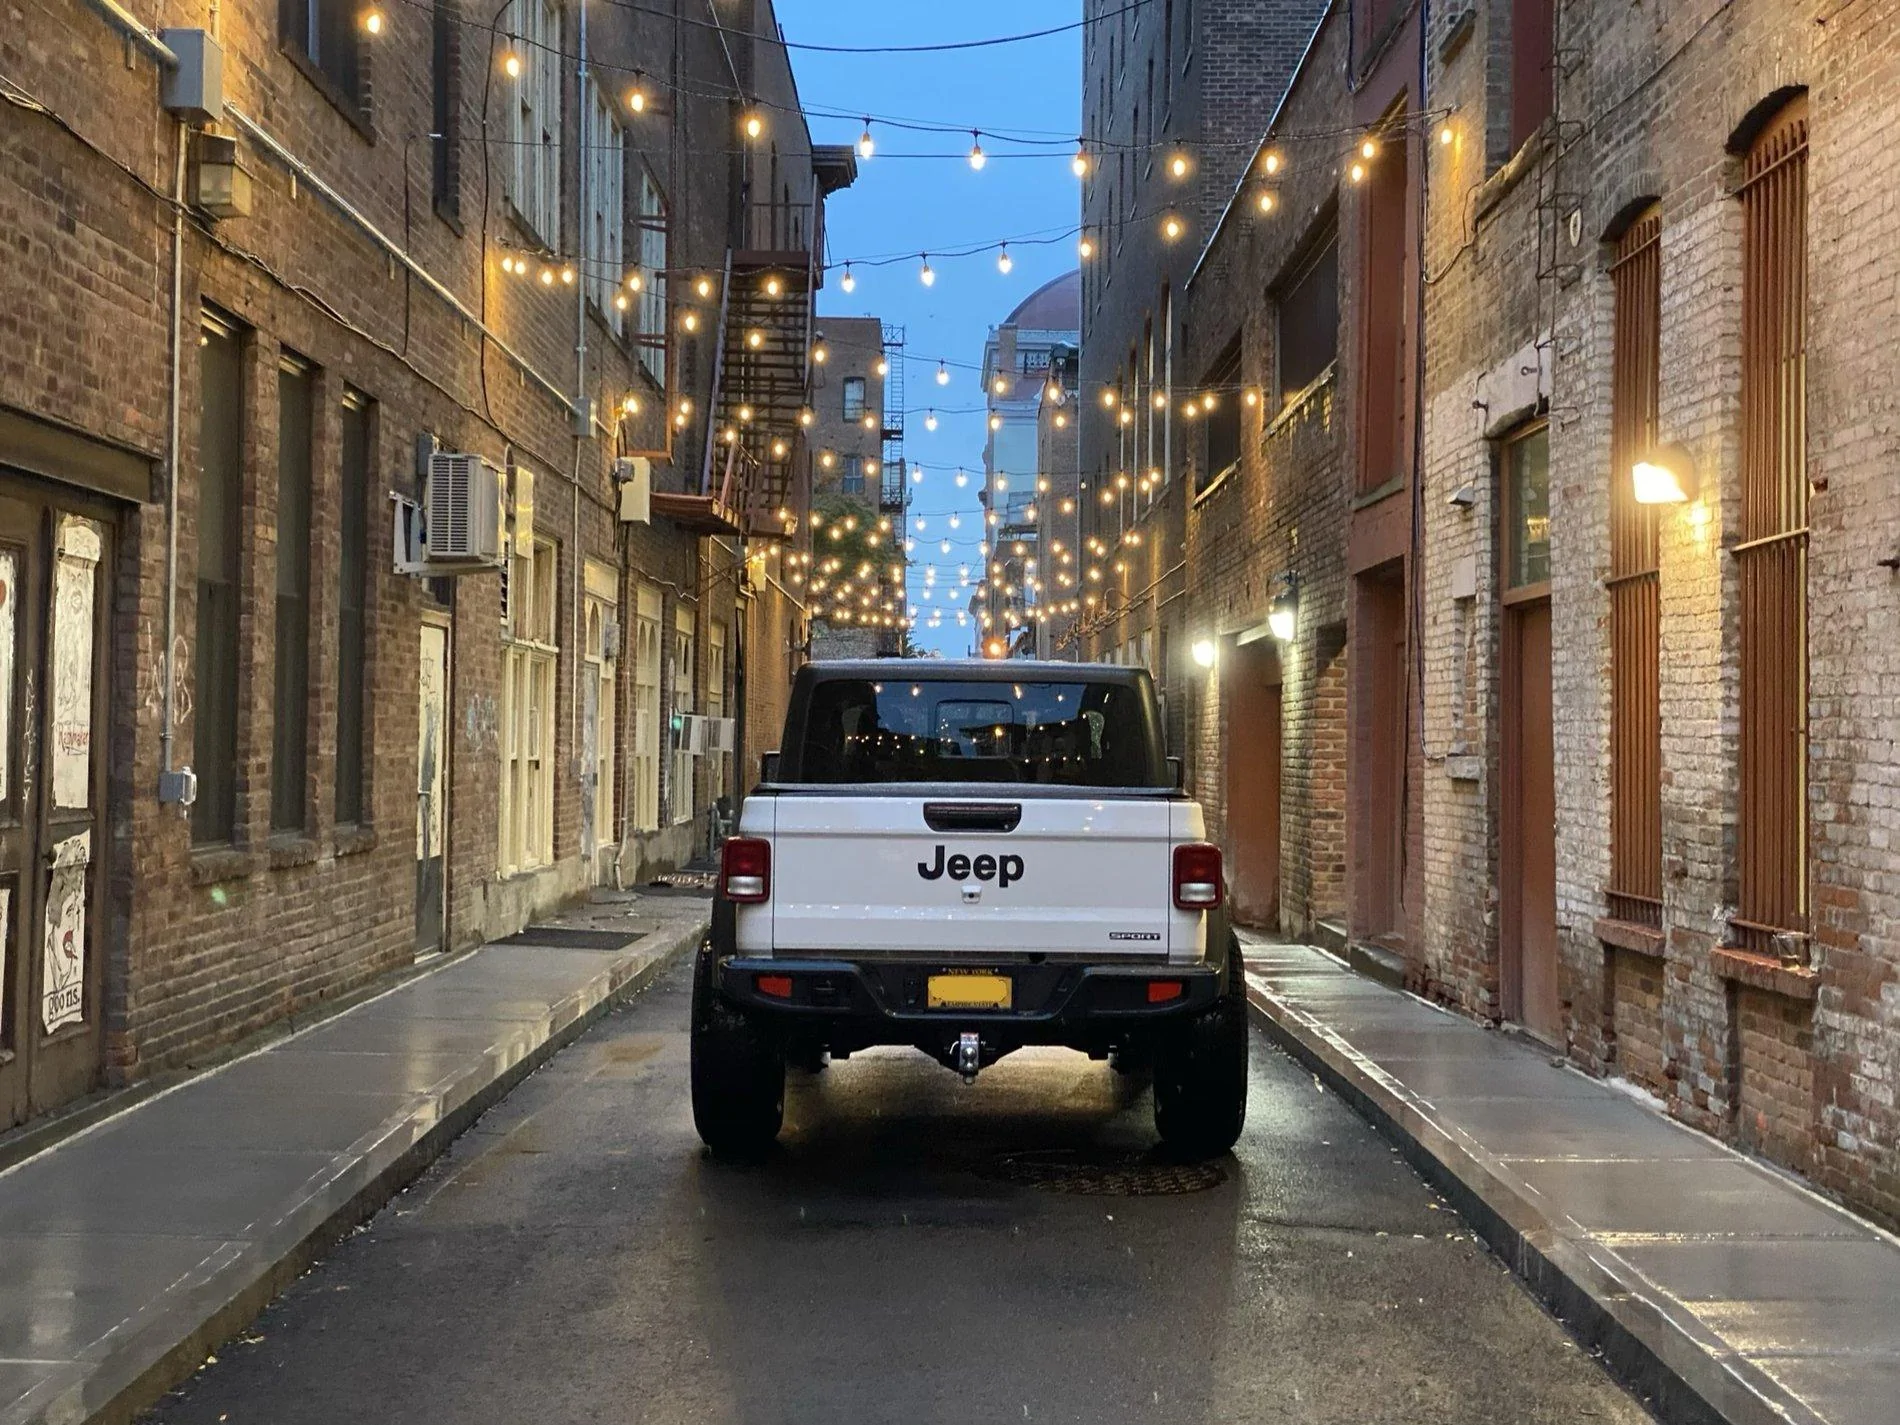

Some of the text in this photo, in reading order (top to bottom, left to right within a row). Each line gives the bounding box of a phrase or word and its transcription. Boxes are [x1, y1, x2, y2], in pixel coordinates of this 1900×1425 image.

[918, 845, 1024, 888] Jeep
[1110, 932, 1160, 940] SPORT
[948, 967, 993, 975] NEW YORK
